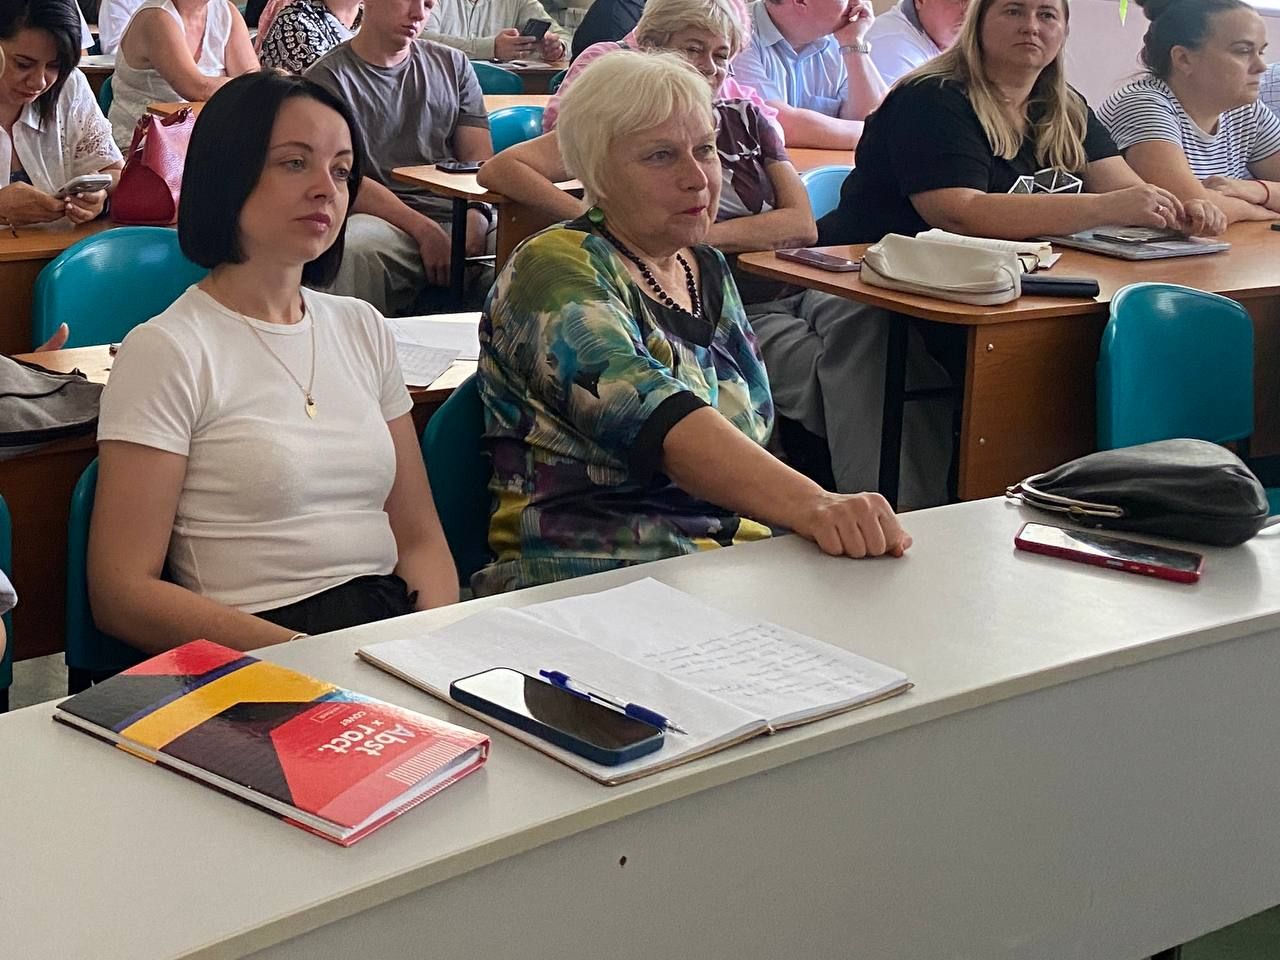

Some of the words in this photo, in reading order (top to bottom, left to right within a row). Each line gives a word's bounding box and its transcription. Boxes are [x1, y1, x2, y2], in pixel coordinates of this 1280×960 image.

[339, 710, 367, 727] cover
[317, 724, 377, 754] ract.
[354, 723, 417, 756] Abst
